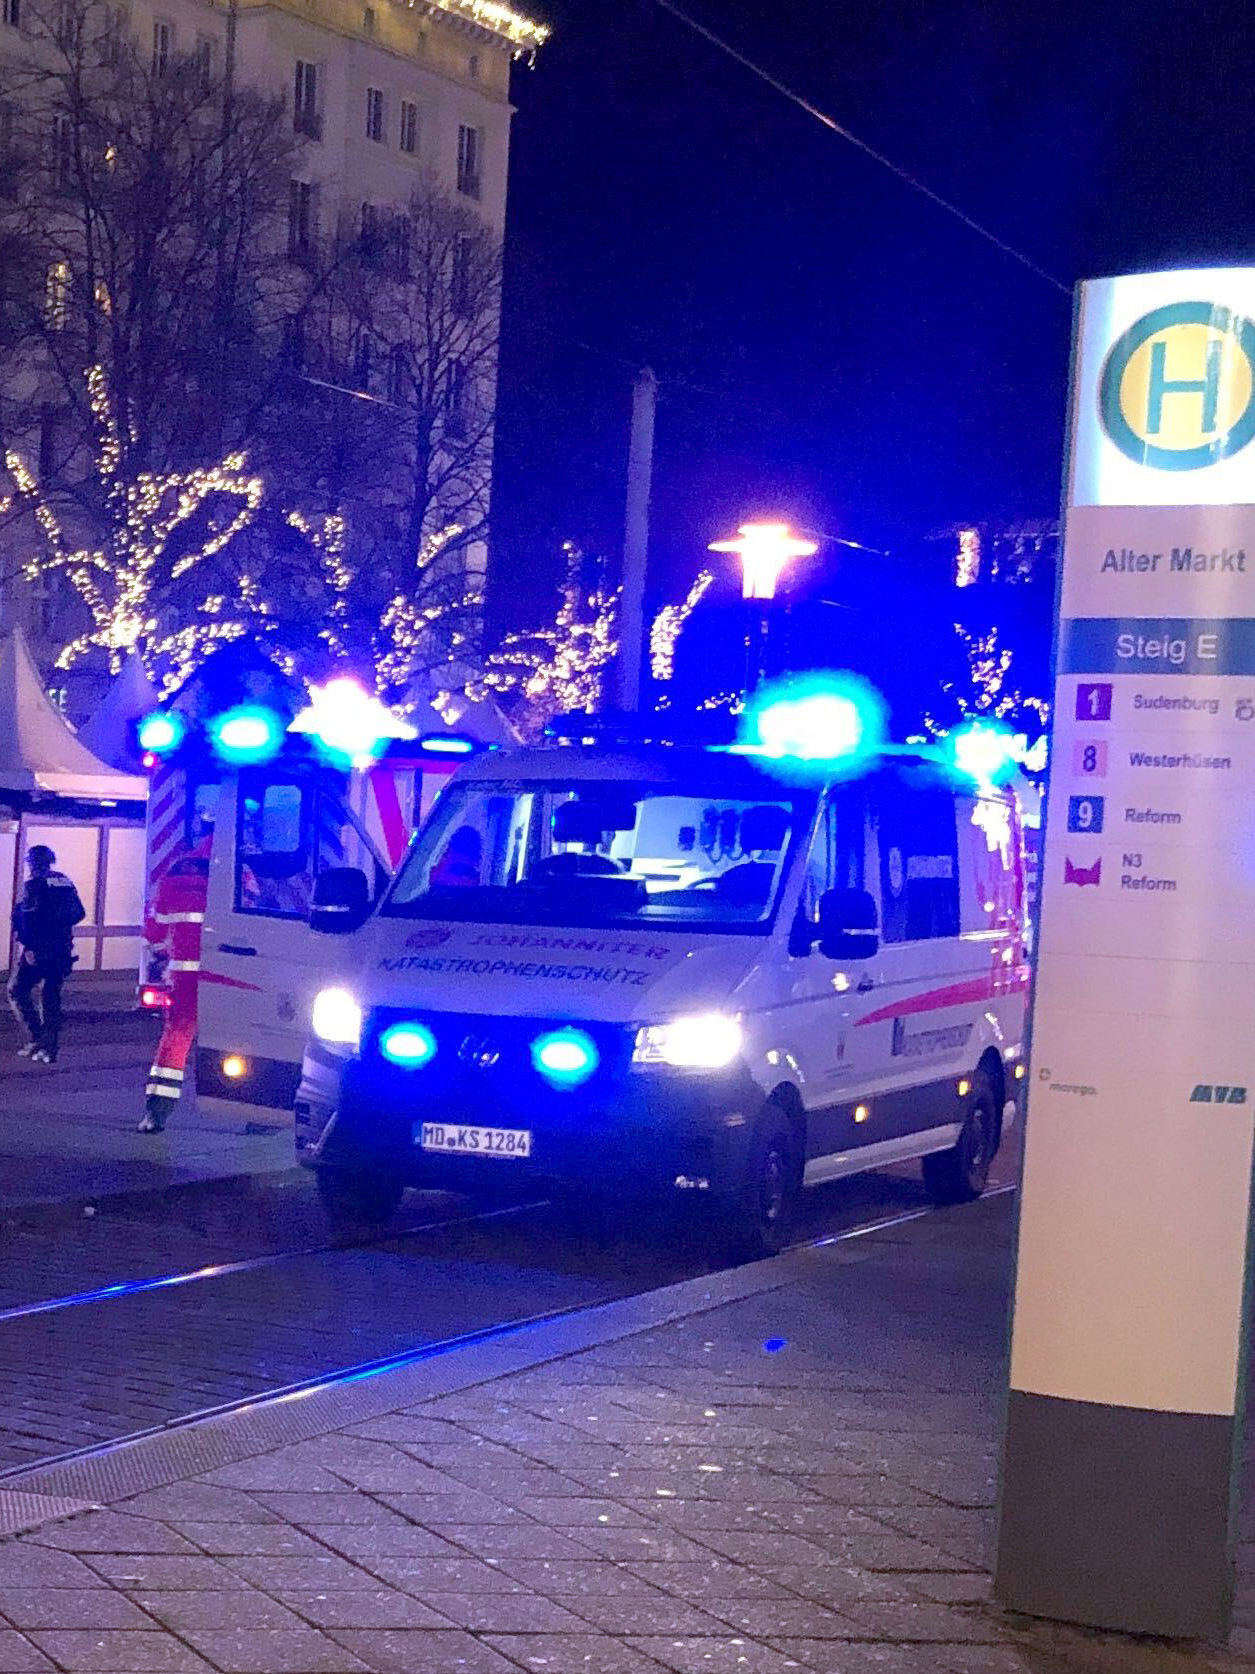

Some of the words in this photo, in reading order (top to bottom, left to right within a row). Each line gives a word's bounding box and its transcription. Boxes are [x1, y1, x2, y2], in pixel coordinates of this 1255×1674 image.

[1146, 340, 1222, 434] H
[1100, 548, 1163, 573] Alter
[1169, 547, 1246, 573] Markt
[1116, 633, 1186, 665] Steig
[1196, 634, 1219, 659] E
[1087, 688, 1100, 718] 1
[1133, 694, 1220, 715] Sudenburg
[1082, 745, 1097, 772] 8
[1129, 751, 1232, 769] Westerhüsen
[1078, 801, 1094, 828] 9
[1124, 807, 1182, 824] Reform
[1122, 853, 1143, 868] N3
[1120, 874, 1177, 891] Reform
[470, 934, 671, 960] JOHANNITER
[377, 956, 651, 986] KATASTROPHENSCHUTZ
[422, 1125, 445, 1147] MD
[457, 1129, 480, 1149] KS
[484, 1130, 527, 1154] 1284
